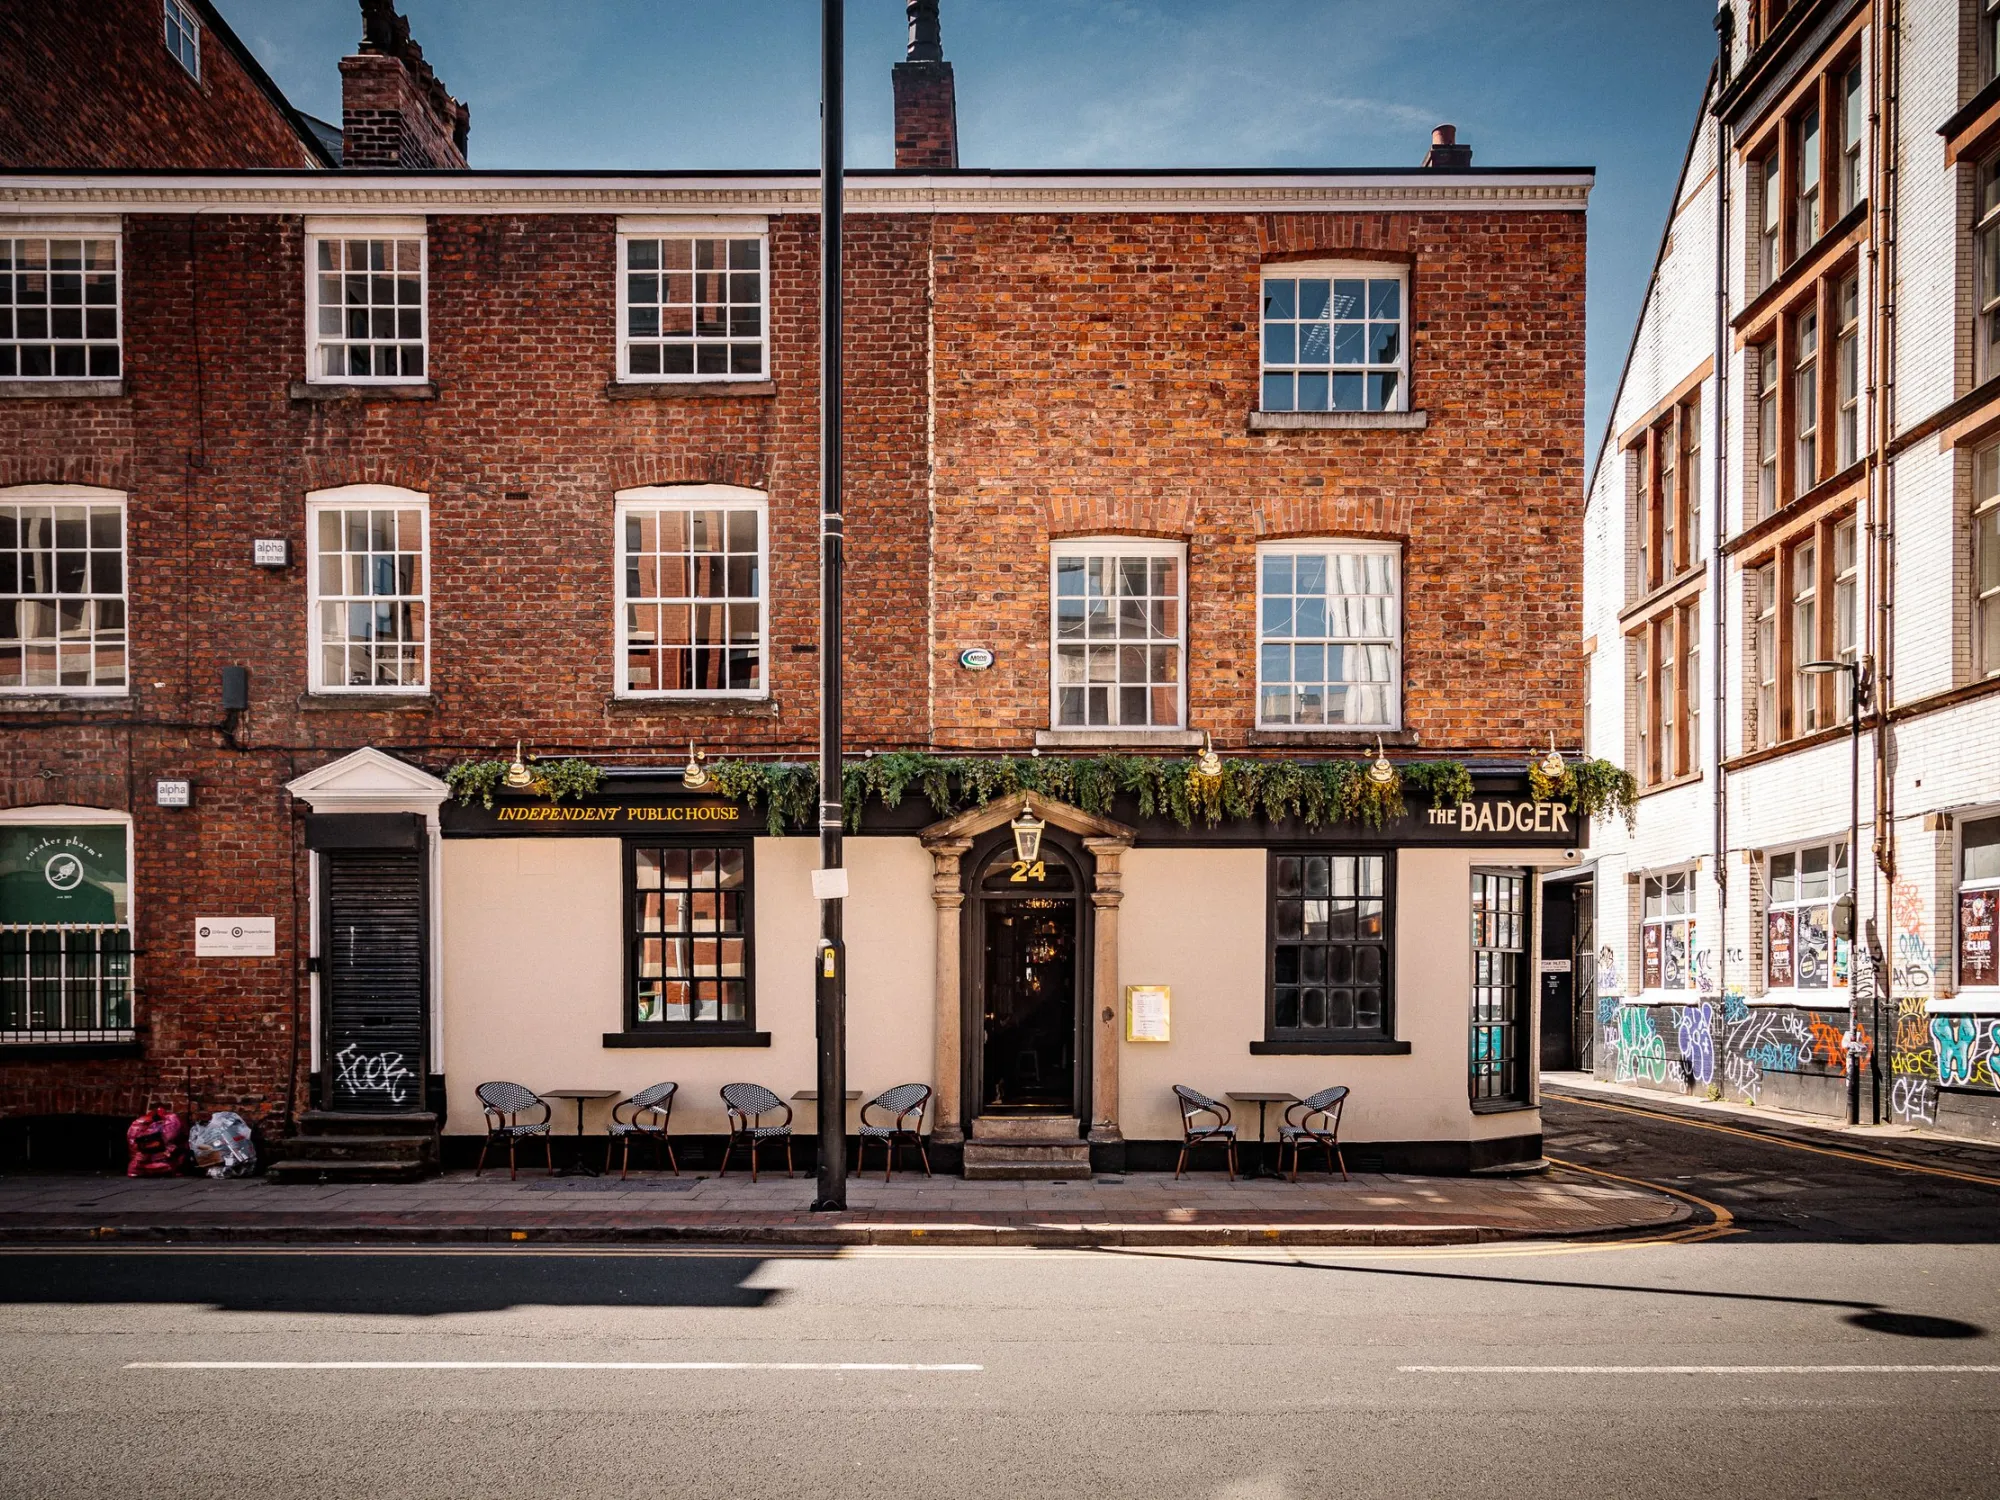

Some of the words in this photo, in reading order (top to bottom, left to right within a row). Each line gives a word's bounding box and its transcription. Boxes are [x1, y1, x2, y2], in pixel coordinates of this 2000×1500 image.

[257, 542, 283, 554] alpha
[159, 784, 186, 796] alpha
[497, 806, 622, 821] INDEPENDENT
[627, 807, 683, 821] PUBLIC
[685, 807, 739, 821] HOUSE
[1428, 809, 1457, 824] THE
[1460, 802, 1569, 832] BADGER
[25, 837, 61, 861] sneaker
[65, 836, 96, 856] pharm
[1010, 861, 1046, 882] 24
[1968, 932, 1990, 941] DART
[1967, 940, 1991, 951] CLUB
